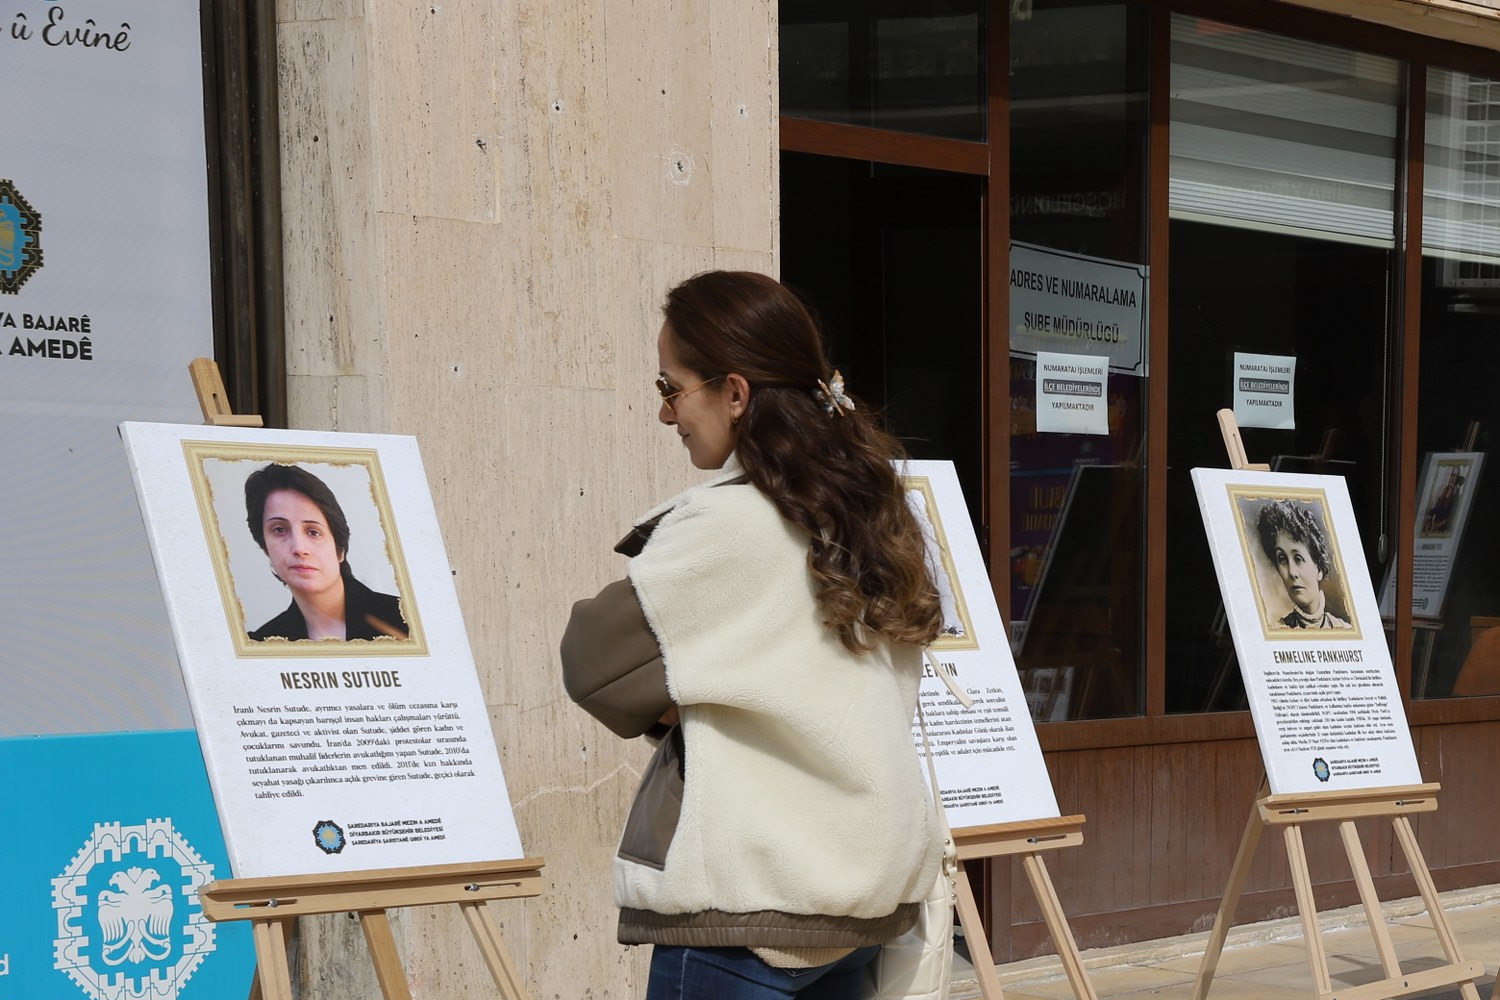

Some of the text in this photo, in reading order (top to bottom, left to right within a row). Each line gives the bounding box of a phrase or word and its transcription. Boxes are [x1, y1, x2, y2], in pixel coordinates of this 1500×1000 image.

[11, 6, 131, 52] û Evînê
[1010, 269, 1136, 308] ADRES VE NUMARALAMA
[23, 313, 91, 333] BAJARÊ
[1024, 312, 1050, 332] ŞUBE
[8, 336, 93, 360] AMEDÊ
[1044, 364, 1076, 373] NUMARATAJ
[1240, 364, 1267, 372] NUMARATAJ
[1051, 402, 1094, 410] YAPILMAKTADIR
[1246, 399, 1282, 407] YAPILMAKTADIR
[1273, 650, 1363, 664] EMMELINE PANKHURST
[280, 671, 402, 689] NESRIN SUTUDE
[233, 705, 254, 714] İranlı
[344, 704, 374, 712] yasalara
[440, 701, 458, 709] karşı
[236, 718, 266, 727] çıkmayı
[268, 717, 278, 725] da
[279, 717, 315, 726] kapsayan
[315, 716, 343, 725] barışçıl
[393, 714, 432, 723] çalışmaları
[271, 729, 300, 738] gazeteci
[314, 728, 340, 736] aktivist
[389, 726, 410, 734] şiddet
[412, 726, 432, 734] gören
[243, 742, 285, 751] çocuklarını
[395, 737, 431, 746] protestolar
[436, 735, 467, 743] sırasında
[246, 754, 287, 762] tutuklanan
[288, 752, 317, 761] muhalif
[353, 750, 394, 759] avukatlığını
[249, 765, 298, 774] tutuklanarak
[302, 764, 347, 772] avukatlıktan
[440, 758, 472, 766] hakkında
[252, 779, 280, 788] seyahat
[281, 778, 304, 787] yasağı
[305, 776, 343, 786] çıkarılınca
[344, 775, 361, 784] açlık
[362, 774, 388, 783] grevine
[388, 774, 407, 782] giren
[434, 771, 453, 780] geçici
[255, 791, 280, 800] tahliye
